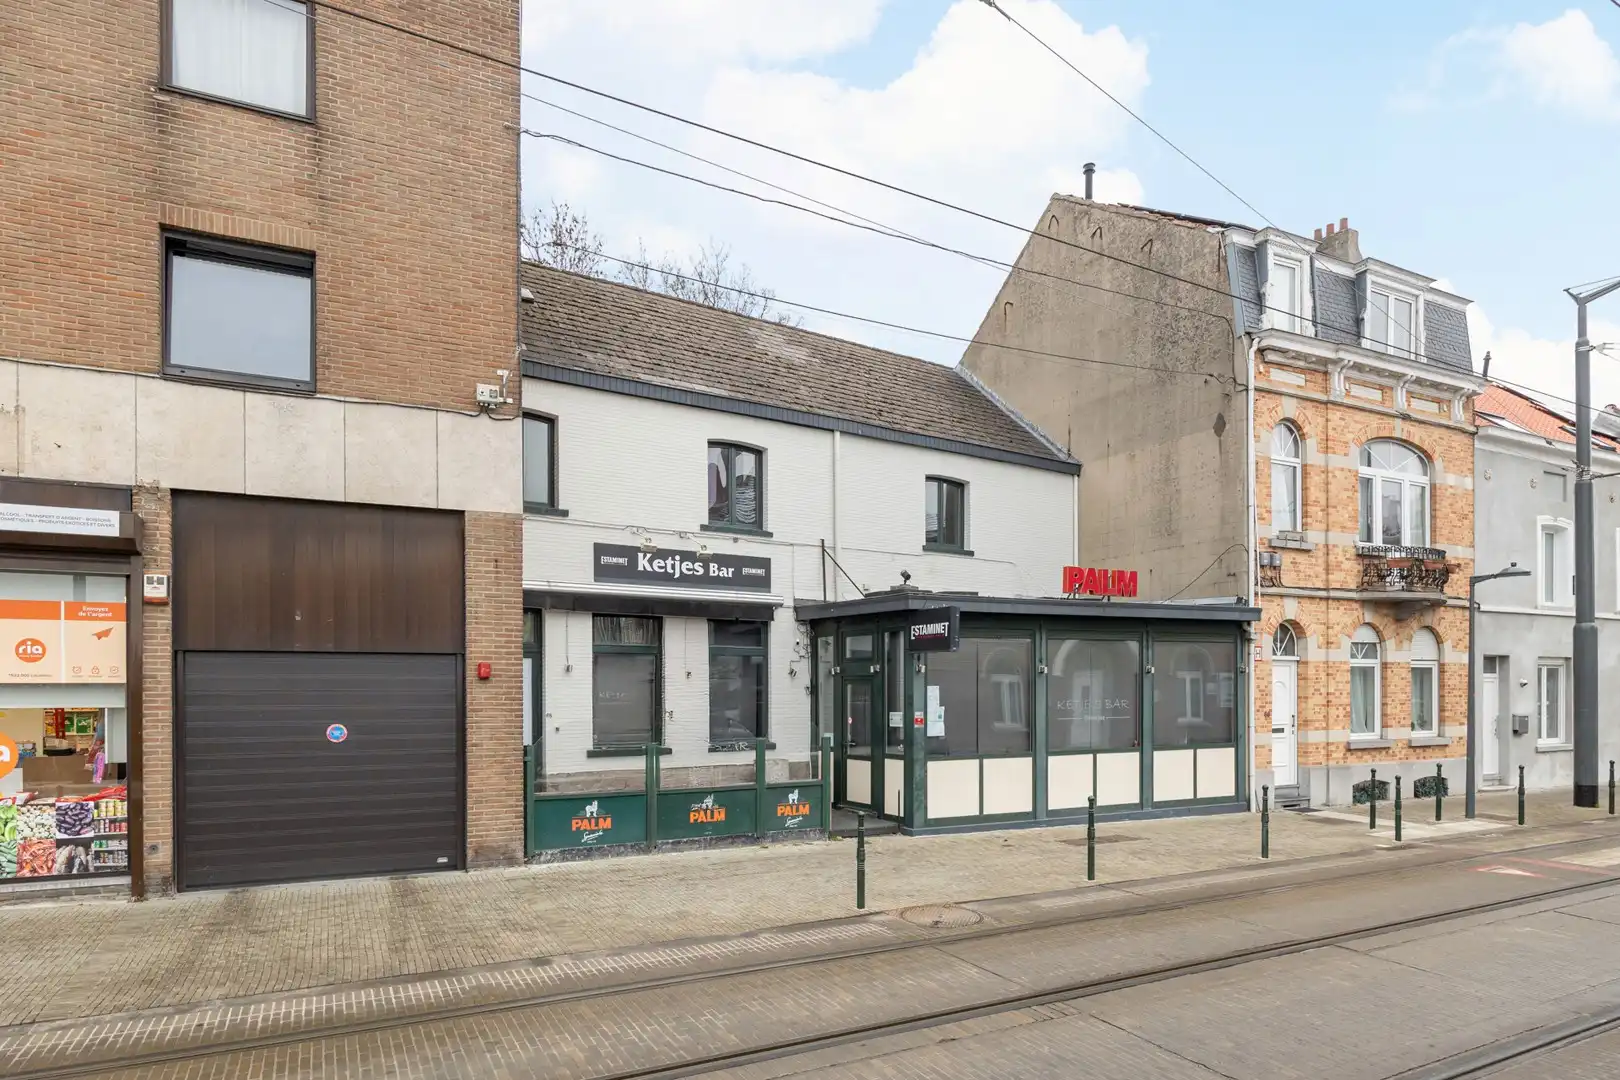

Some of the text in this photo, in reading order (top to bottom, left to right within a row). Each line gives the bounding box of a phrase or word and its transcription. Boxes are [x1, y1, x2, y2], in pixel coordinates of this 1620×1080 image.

[601, 555, 628, 566] ESTAMINET
[637, 552, 735, 579] Ketjes Bar
[742, 567, 766, 577] ESTAMINET
[1063, 566, 1138, 597] PALM
[911, 621, 949, 640] ESTAMINET
[19, 641, 43, 655] ria
[1105, 698, 1130, 710] BAR
[689, 807, 726, 824] PALM
[777, 804, 810, 816] PALM
[571, 817, 612, 832] PALM
